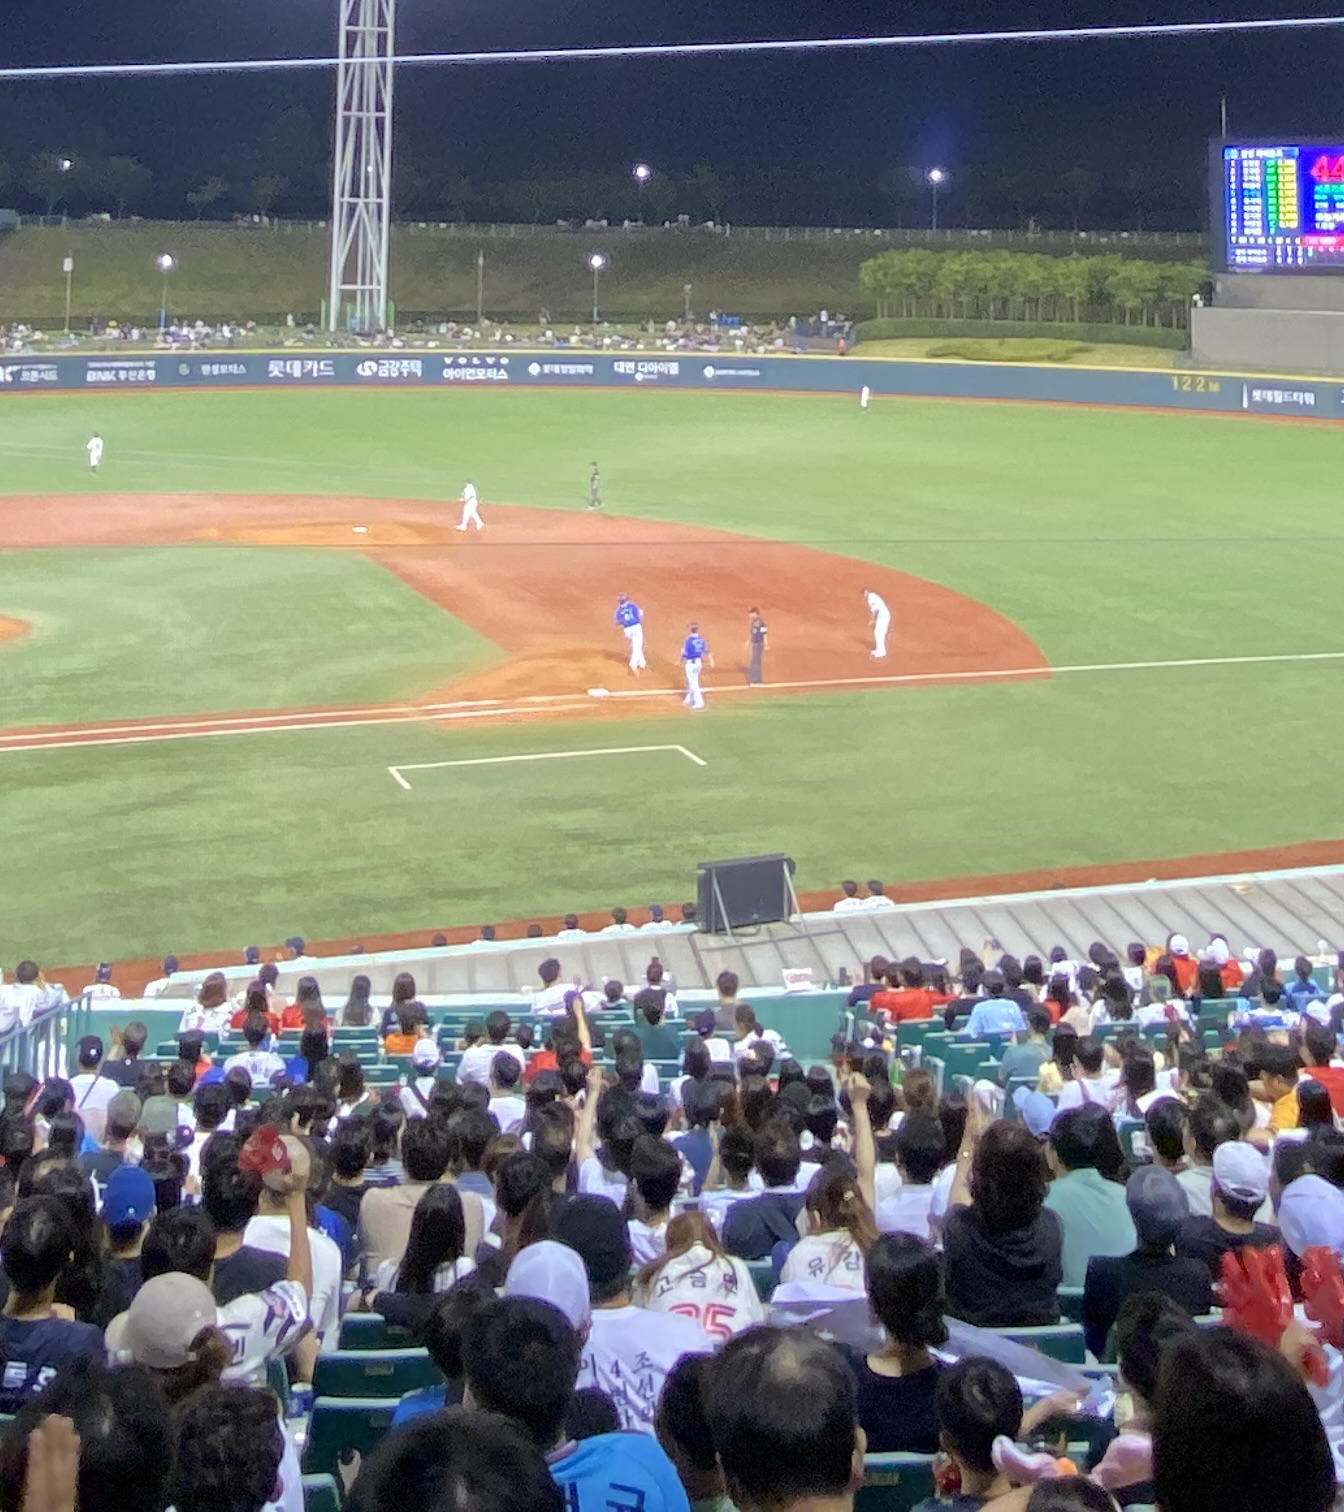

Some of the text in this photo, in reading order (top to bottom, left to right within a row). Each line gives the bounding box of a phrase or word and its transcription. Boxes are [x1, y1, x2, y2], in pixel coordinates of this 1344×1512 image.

[268, 359, 335, 377] 롯데카드
[377, 359, 422, 377] 금강주택
[444, 356, 509, 365] VOLVO
[87, 369, 117, 382] BNK
[442, 367, 509, 381] 아이언모터스
[1252, 388, 1315, 406] 롯데월드타워
